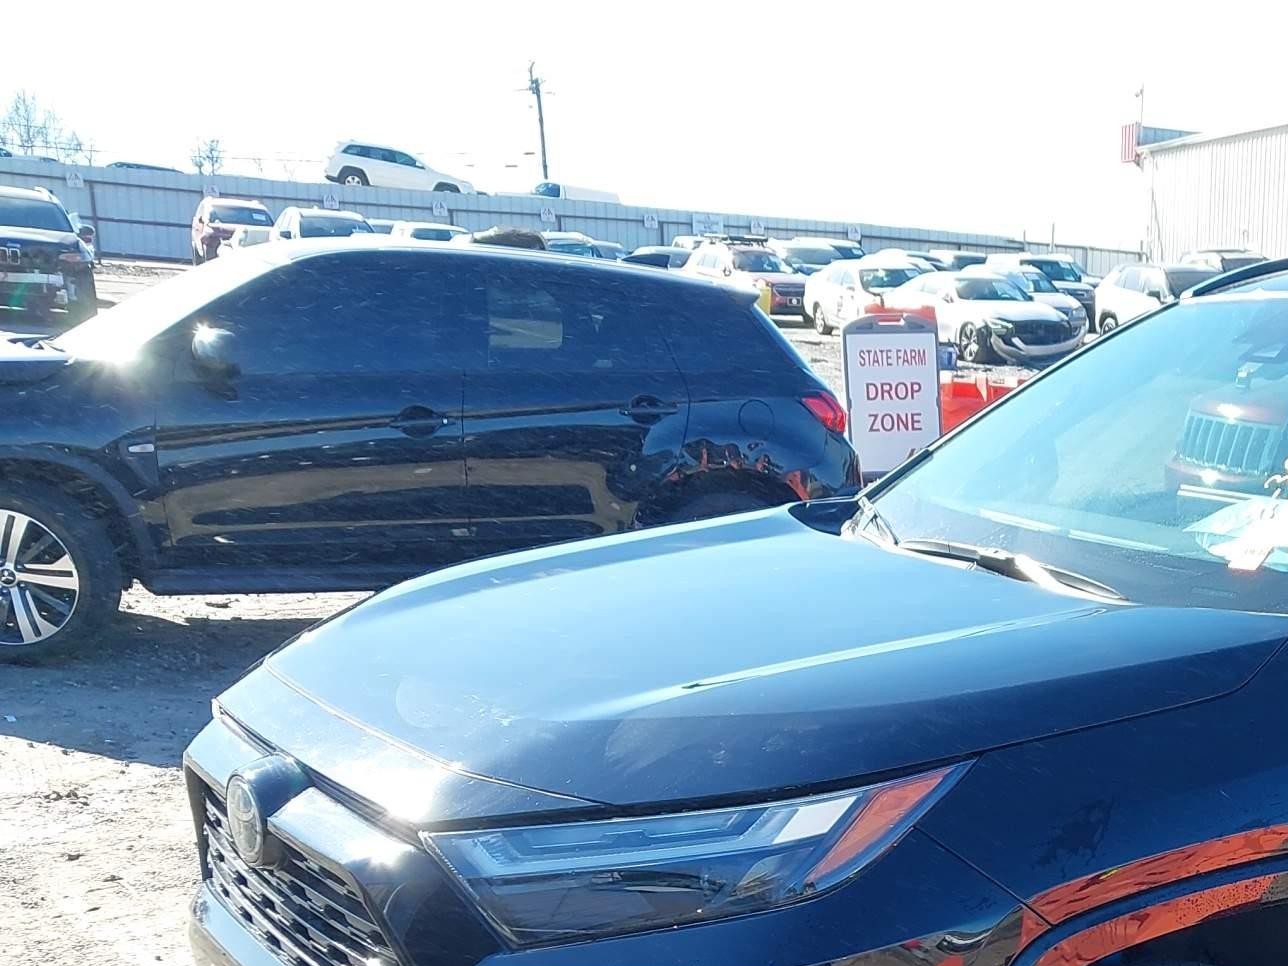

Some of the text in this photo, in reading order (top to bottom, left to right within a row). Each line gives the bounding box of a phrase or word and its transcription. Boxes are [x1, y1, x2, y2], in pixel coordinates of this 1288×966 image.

[858, 348, 927, 367] STATE FARM
[865, 381, 922, 401] DROP
[868, 412, 923, 433] ZONE
